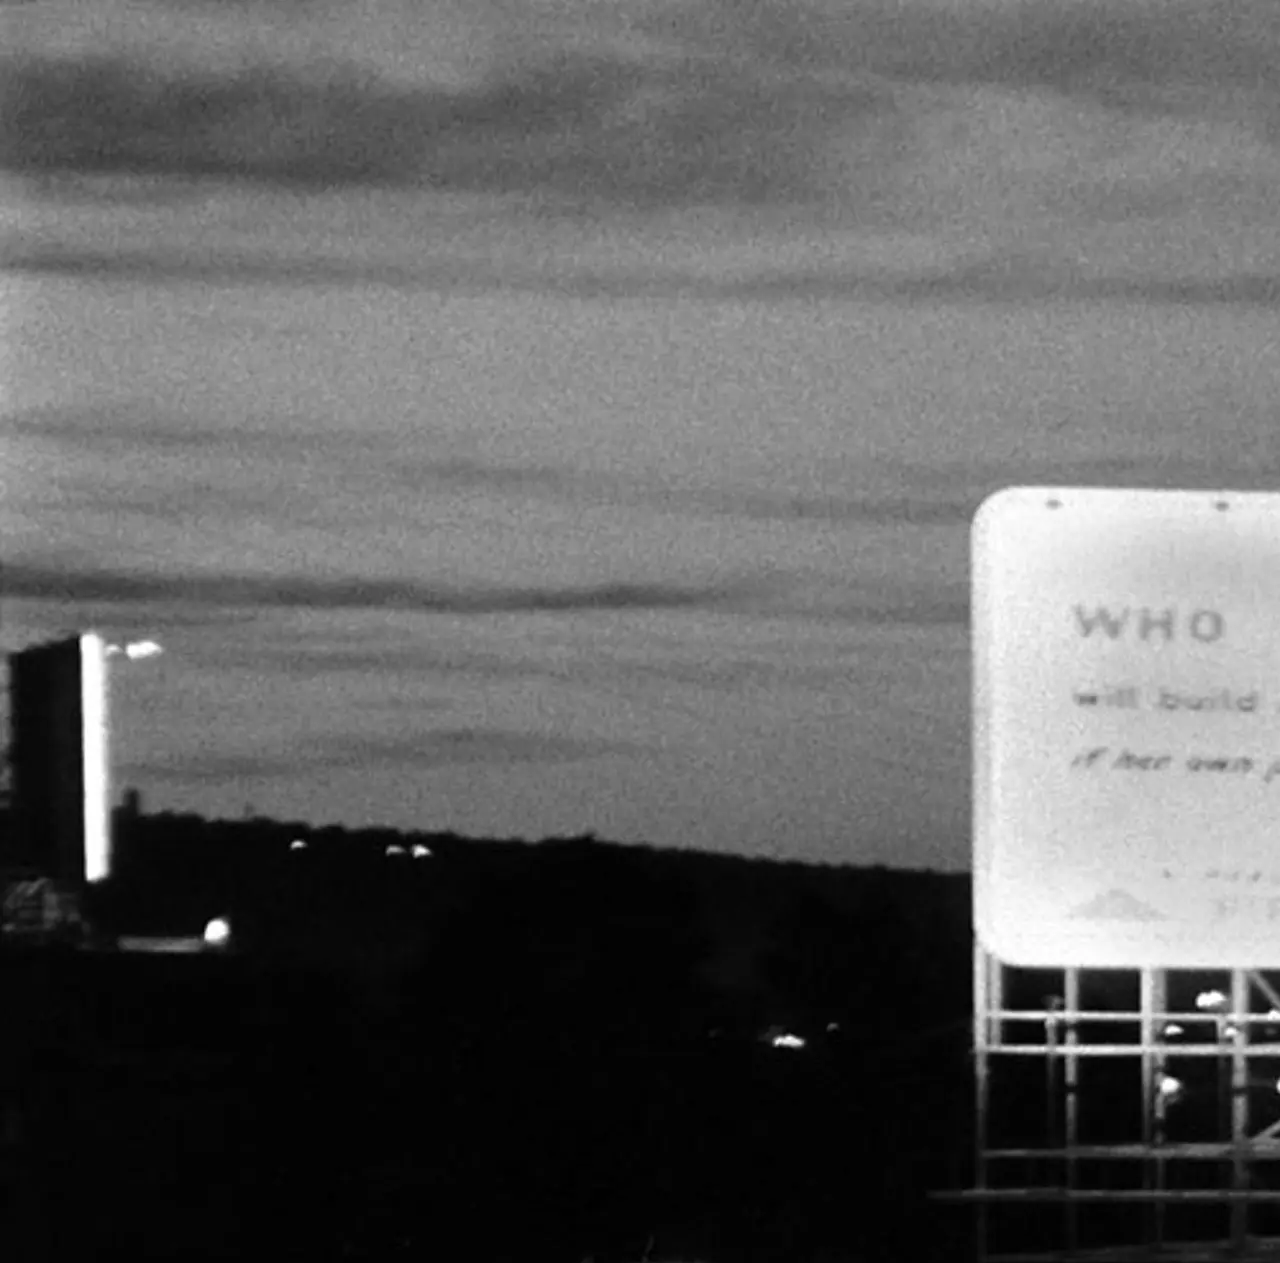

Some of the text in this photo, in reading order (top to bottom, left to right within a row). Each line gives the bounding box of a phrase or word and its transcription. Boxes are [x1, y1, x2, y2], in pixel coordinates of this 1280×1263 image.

[1073, 603, 1226, 644] WHO
[1071, 685, 1138, 710] will
[1156, 685, 1258, 714] build
[1070, 746, 1110, 771] if
[1112, 748, 1172, 772] her
[1186, 756, 1254, 774] own
